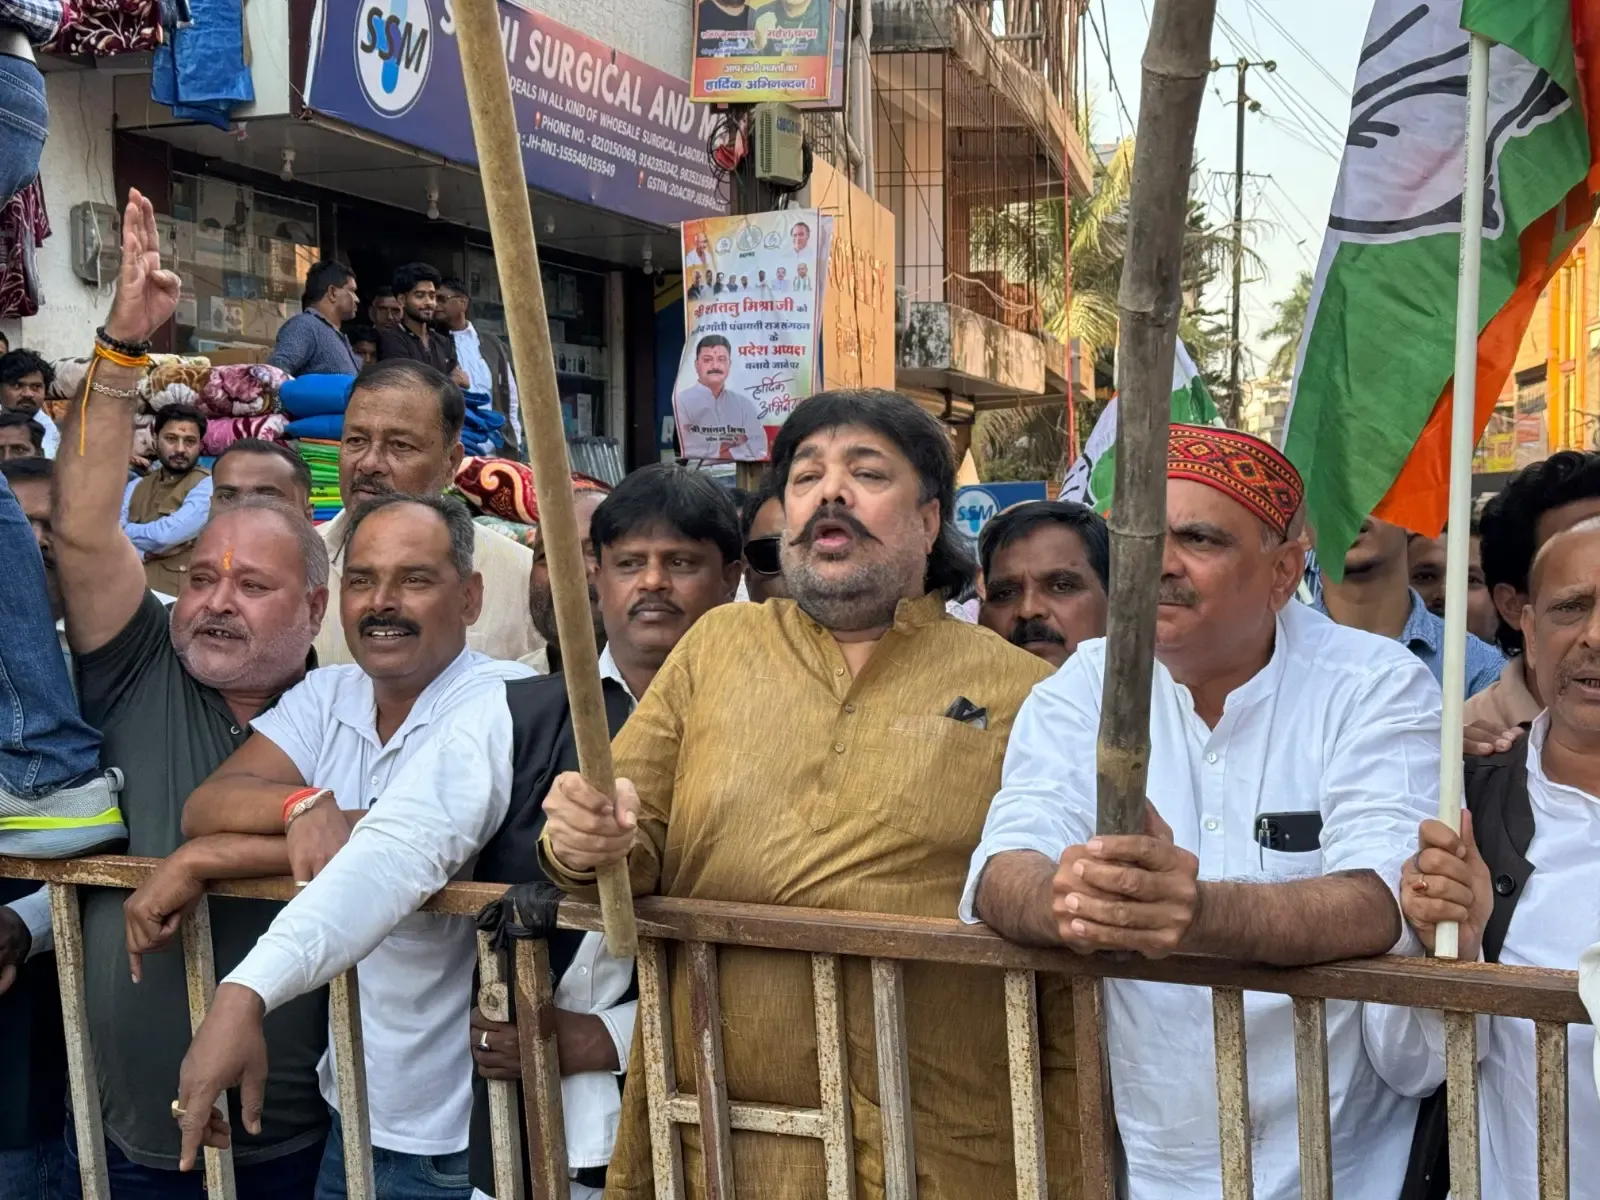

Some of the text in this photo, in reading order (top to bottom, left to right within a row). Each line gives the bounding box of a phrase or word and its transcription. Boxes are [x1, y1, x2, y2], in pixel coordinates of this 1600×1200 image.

[360, 7, 428, 74] SSM
[525, 29, 642, 116] SURGICAL
[648, 85, 695, 134] AND
[704, 75, 742, 91] हार्दिक
[745, 75, 807, 91] अभिनन्दन
[510, 75, 537, 100] DEALS
[538, 87, 548, 104] IN
[548, 91, 564, 112] ALL
[565, 98, 585, 118] KIND
[586, 106, 598, 123] OF
[600, 111, 641, 140] WHOESALE
[541, 115, 570, 138] PHONE
[571, 126, 586, 144] NO.
[743, 296, 774, 312] मिश्रा
[775, 296, 794, 312] जी
[957, 504, 994, 521] SSM
